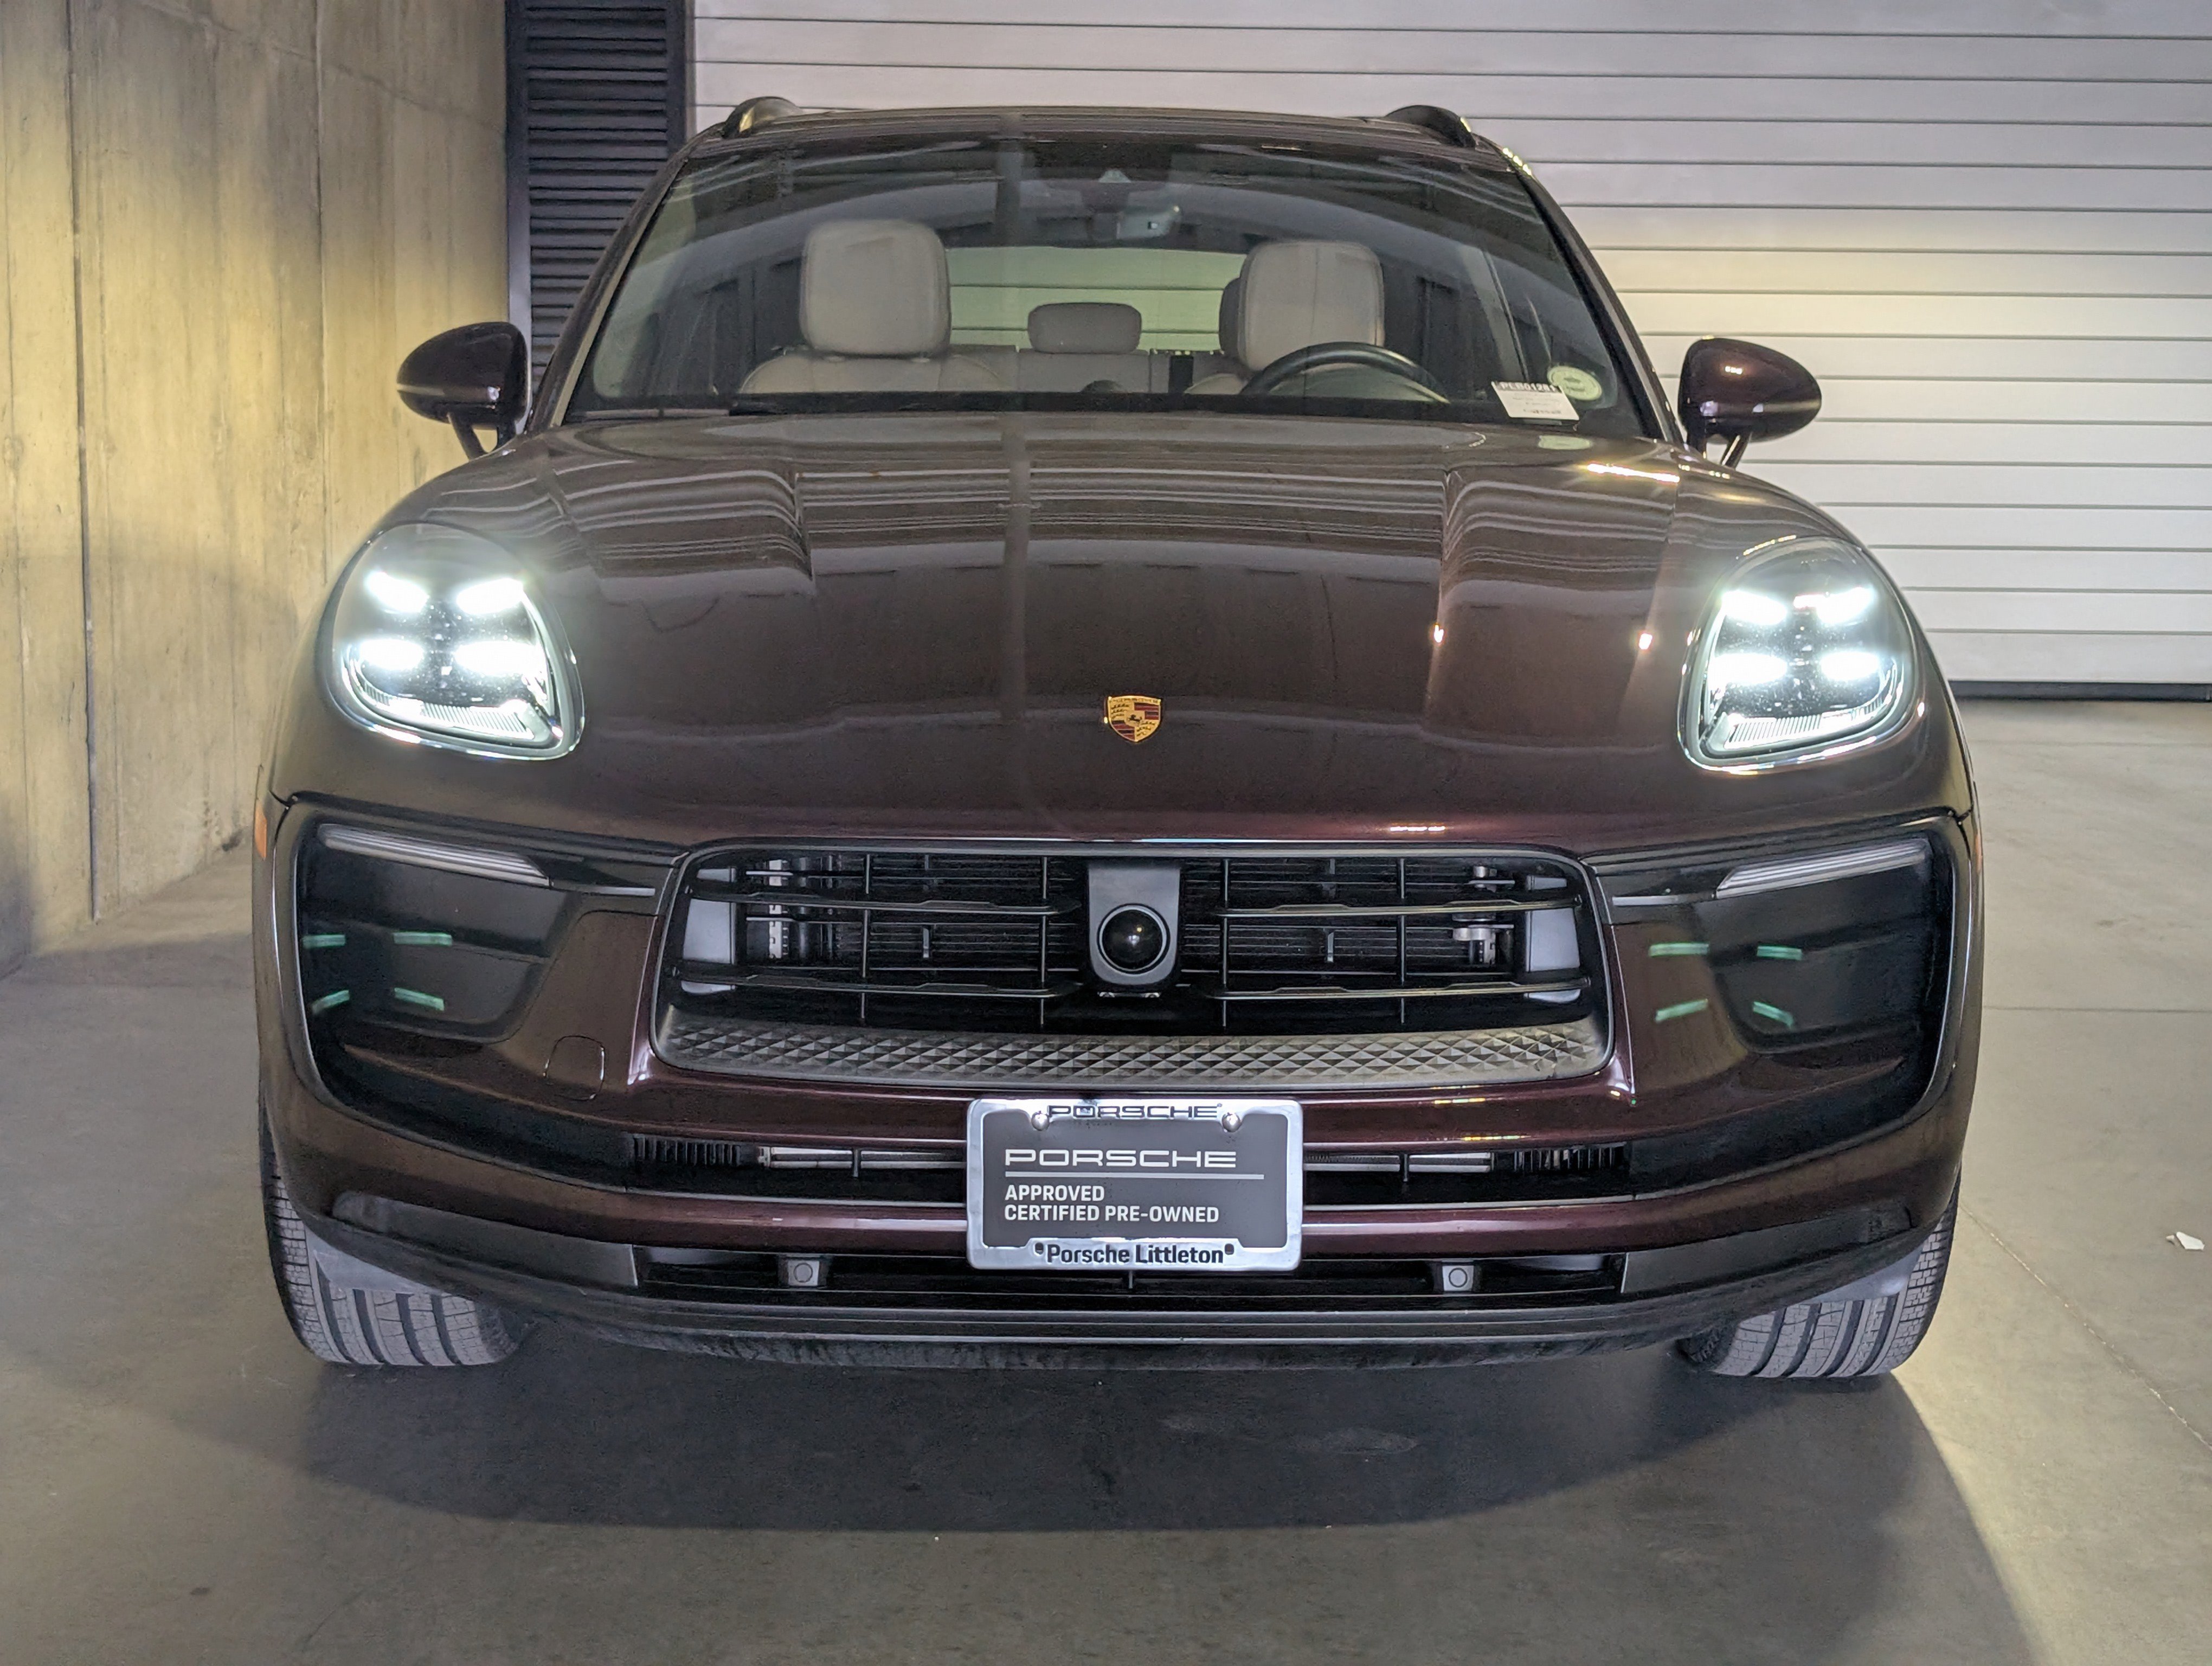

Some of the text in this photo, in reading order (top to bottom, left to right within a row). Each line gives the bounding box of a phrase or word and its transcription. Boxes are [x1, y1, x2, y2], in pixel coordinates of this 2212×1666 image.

[1049, 1105, 1218, 1119] PORSCHE
[1005, 1149, 1236, 1168] PORSCHE
[1005, 1185, 1105, 1201] APPROVED
[1005, 1204, 1219, 1222] CERTIFIED PRE-OWNED
[1047, 1245, 1224, 1264] Porsche Littleton
